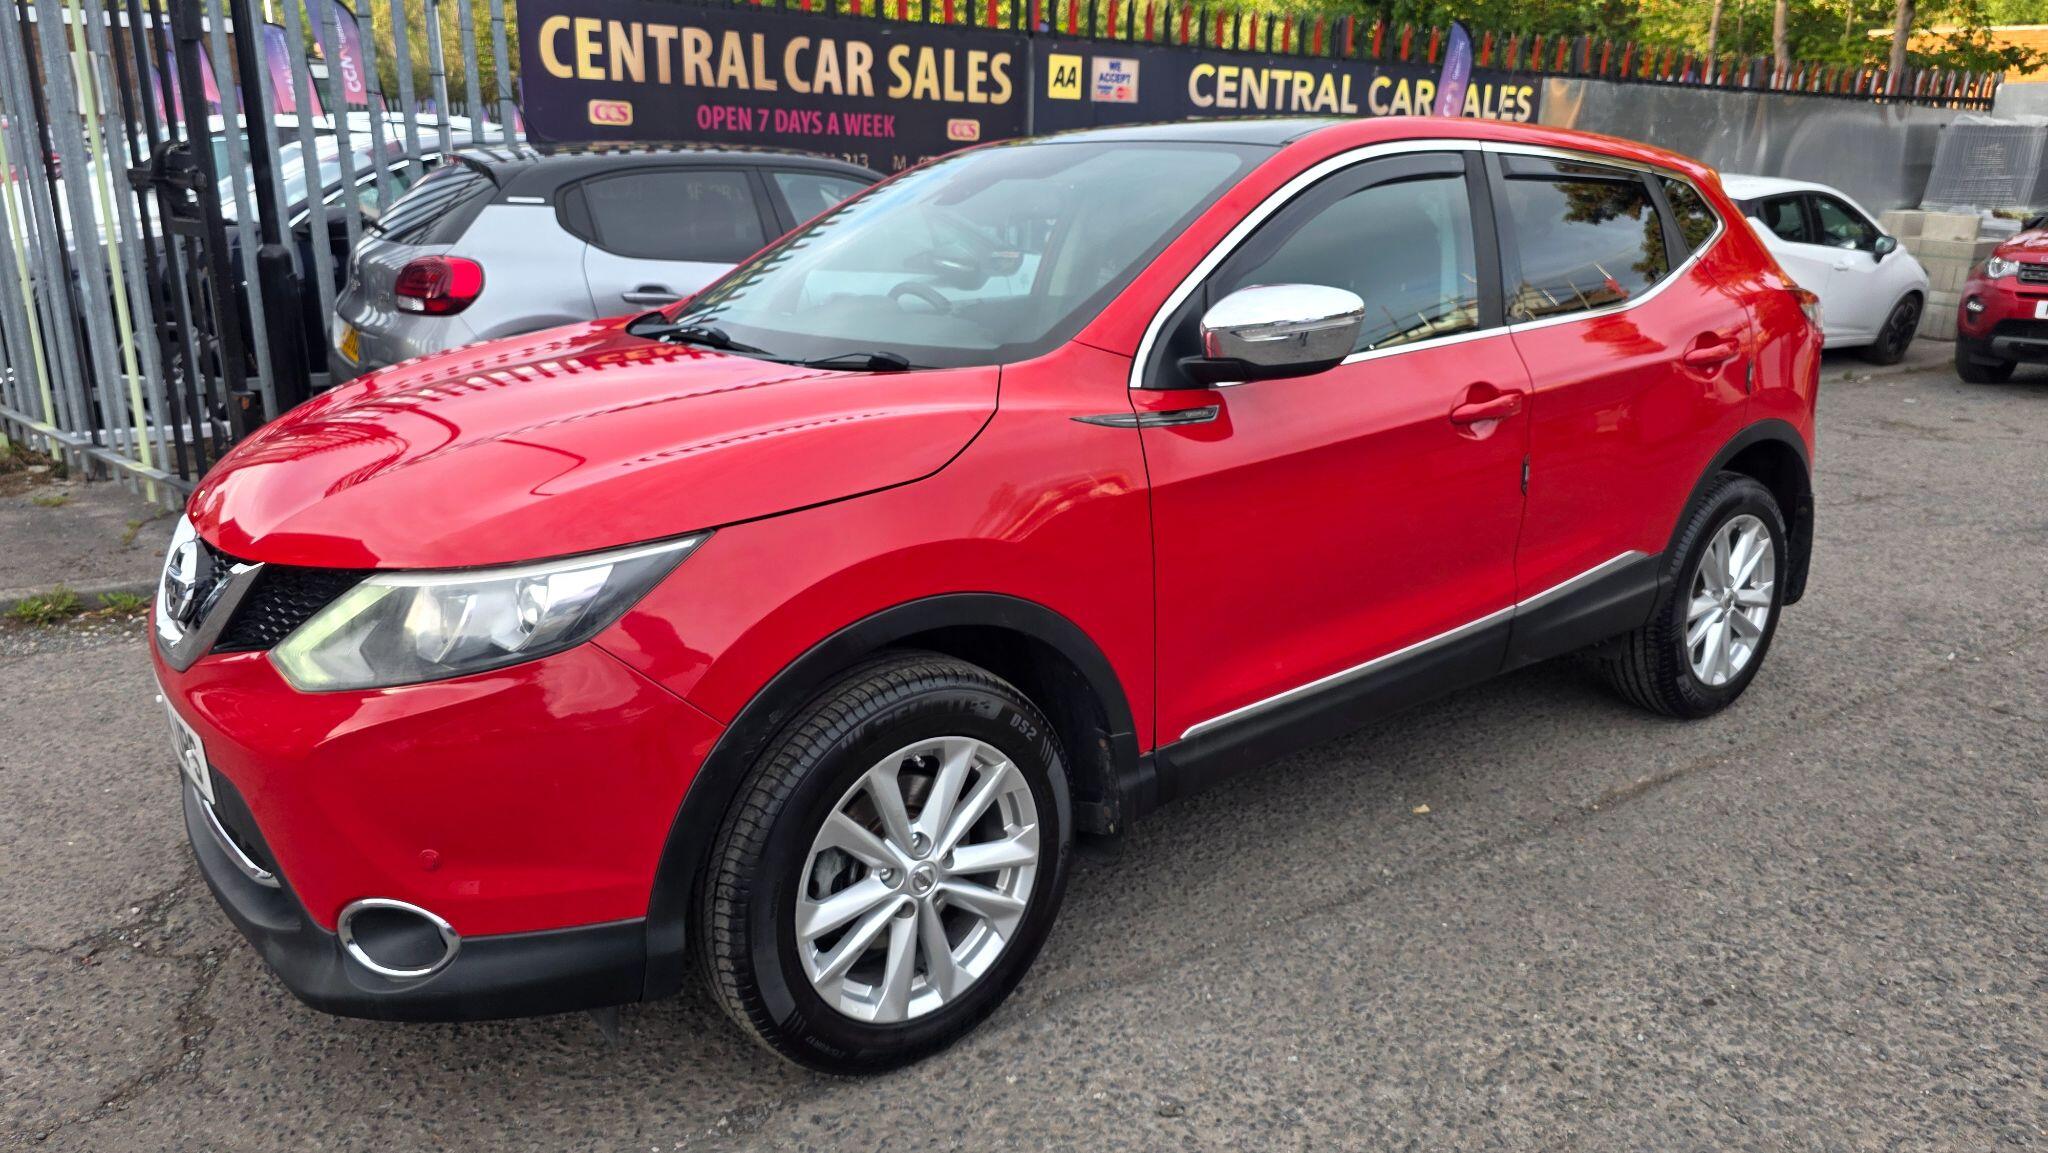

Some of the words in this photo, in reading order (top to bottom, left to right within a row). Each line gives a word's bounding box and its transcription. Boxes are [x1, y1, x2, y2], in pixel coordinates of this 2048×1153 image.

[539, 14, 778, 91] CENTRAL
[783, 35, 875, 97] CAR
[887, 43, 1013, 104] SALES
[1053, 65, 1077, 88] AA
[1188, 63, 1358, 114] CENTRAL
[1368, 75, 1436, 117] CAR
[1462, 83, 1534, 123] ALES
[697, 104, 752, 131] OPEN
[757, 109, 770, 132] 7
[775, 108, 823, 135] DAYS
[827, 112, 840, 136] A
[843, 112, 895, 138] WEEK
[1009, 712, 1038, 741] DS2
